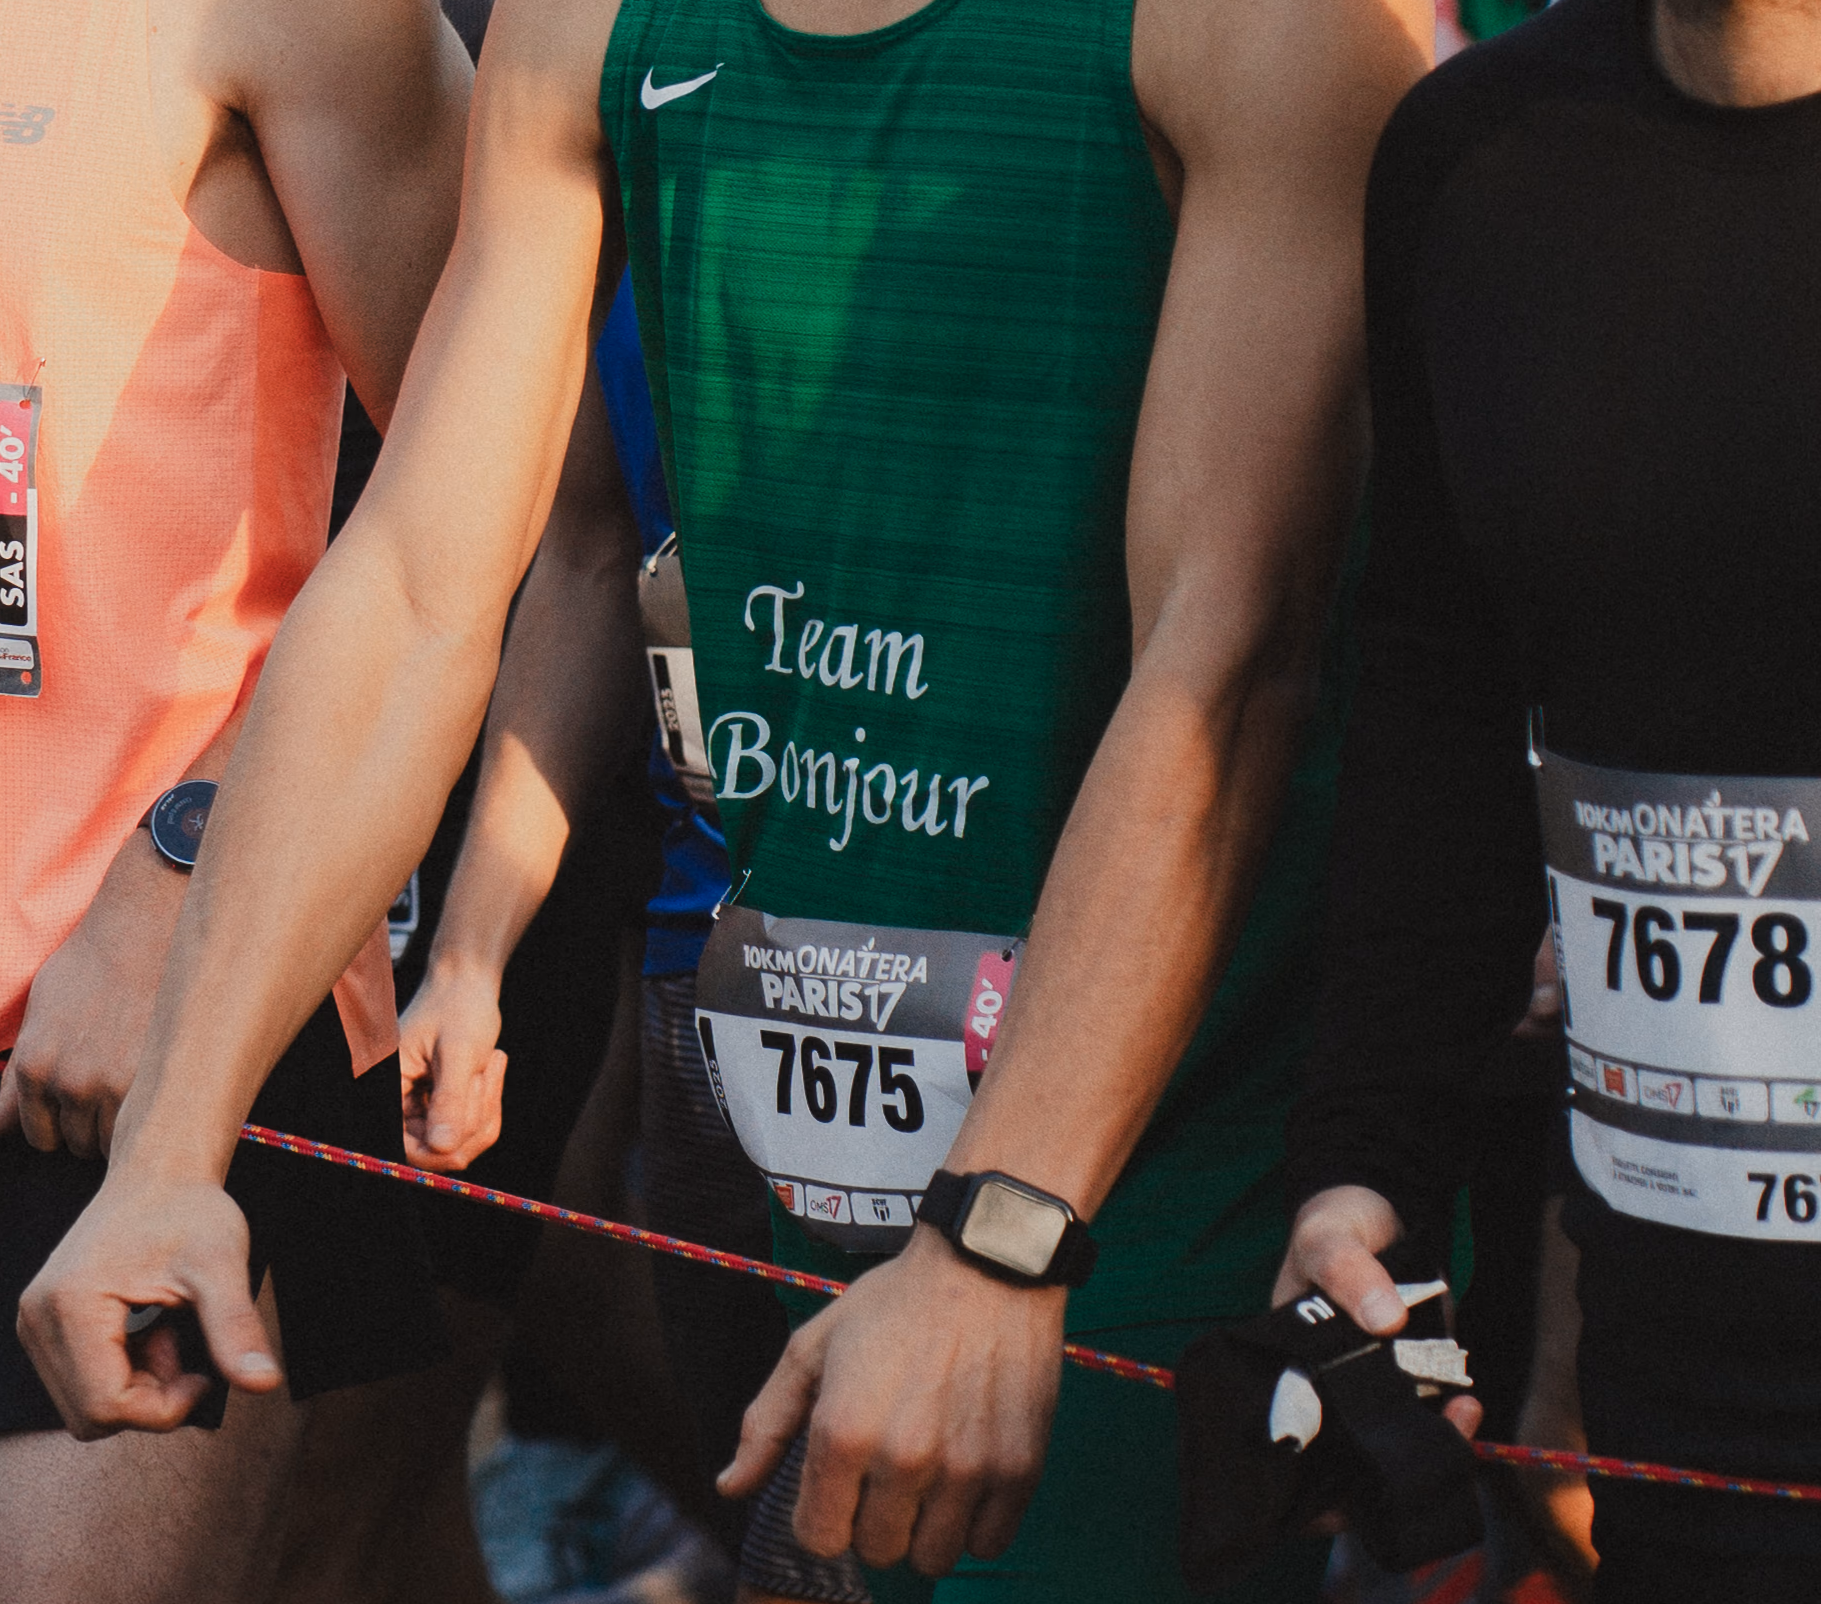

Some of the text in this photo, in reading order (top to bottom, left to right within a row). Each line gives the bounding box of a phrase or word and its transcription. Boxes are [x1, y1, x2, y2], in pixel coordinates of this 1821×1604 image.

[743, 581, 929, 700] Team
[707, 711, 990, 852] Bonjour
[1591, 896, 1813, 1009] 7678
[760, 1029, 925, 1134] 7675
[1746, 1171, 1821, 1224] 76
